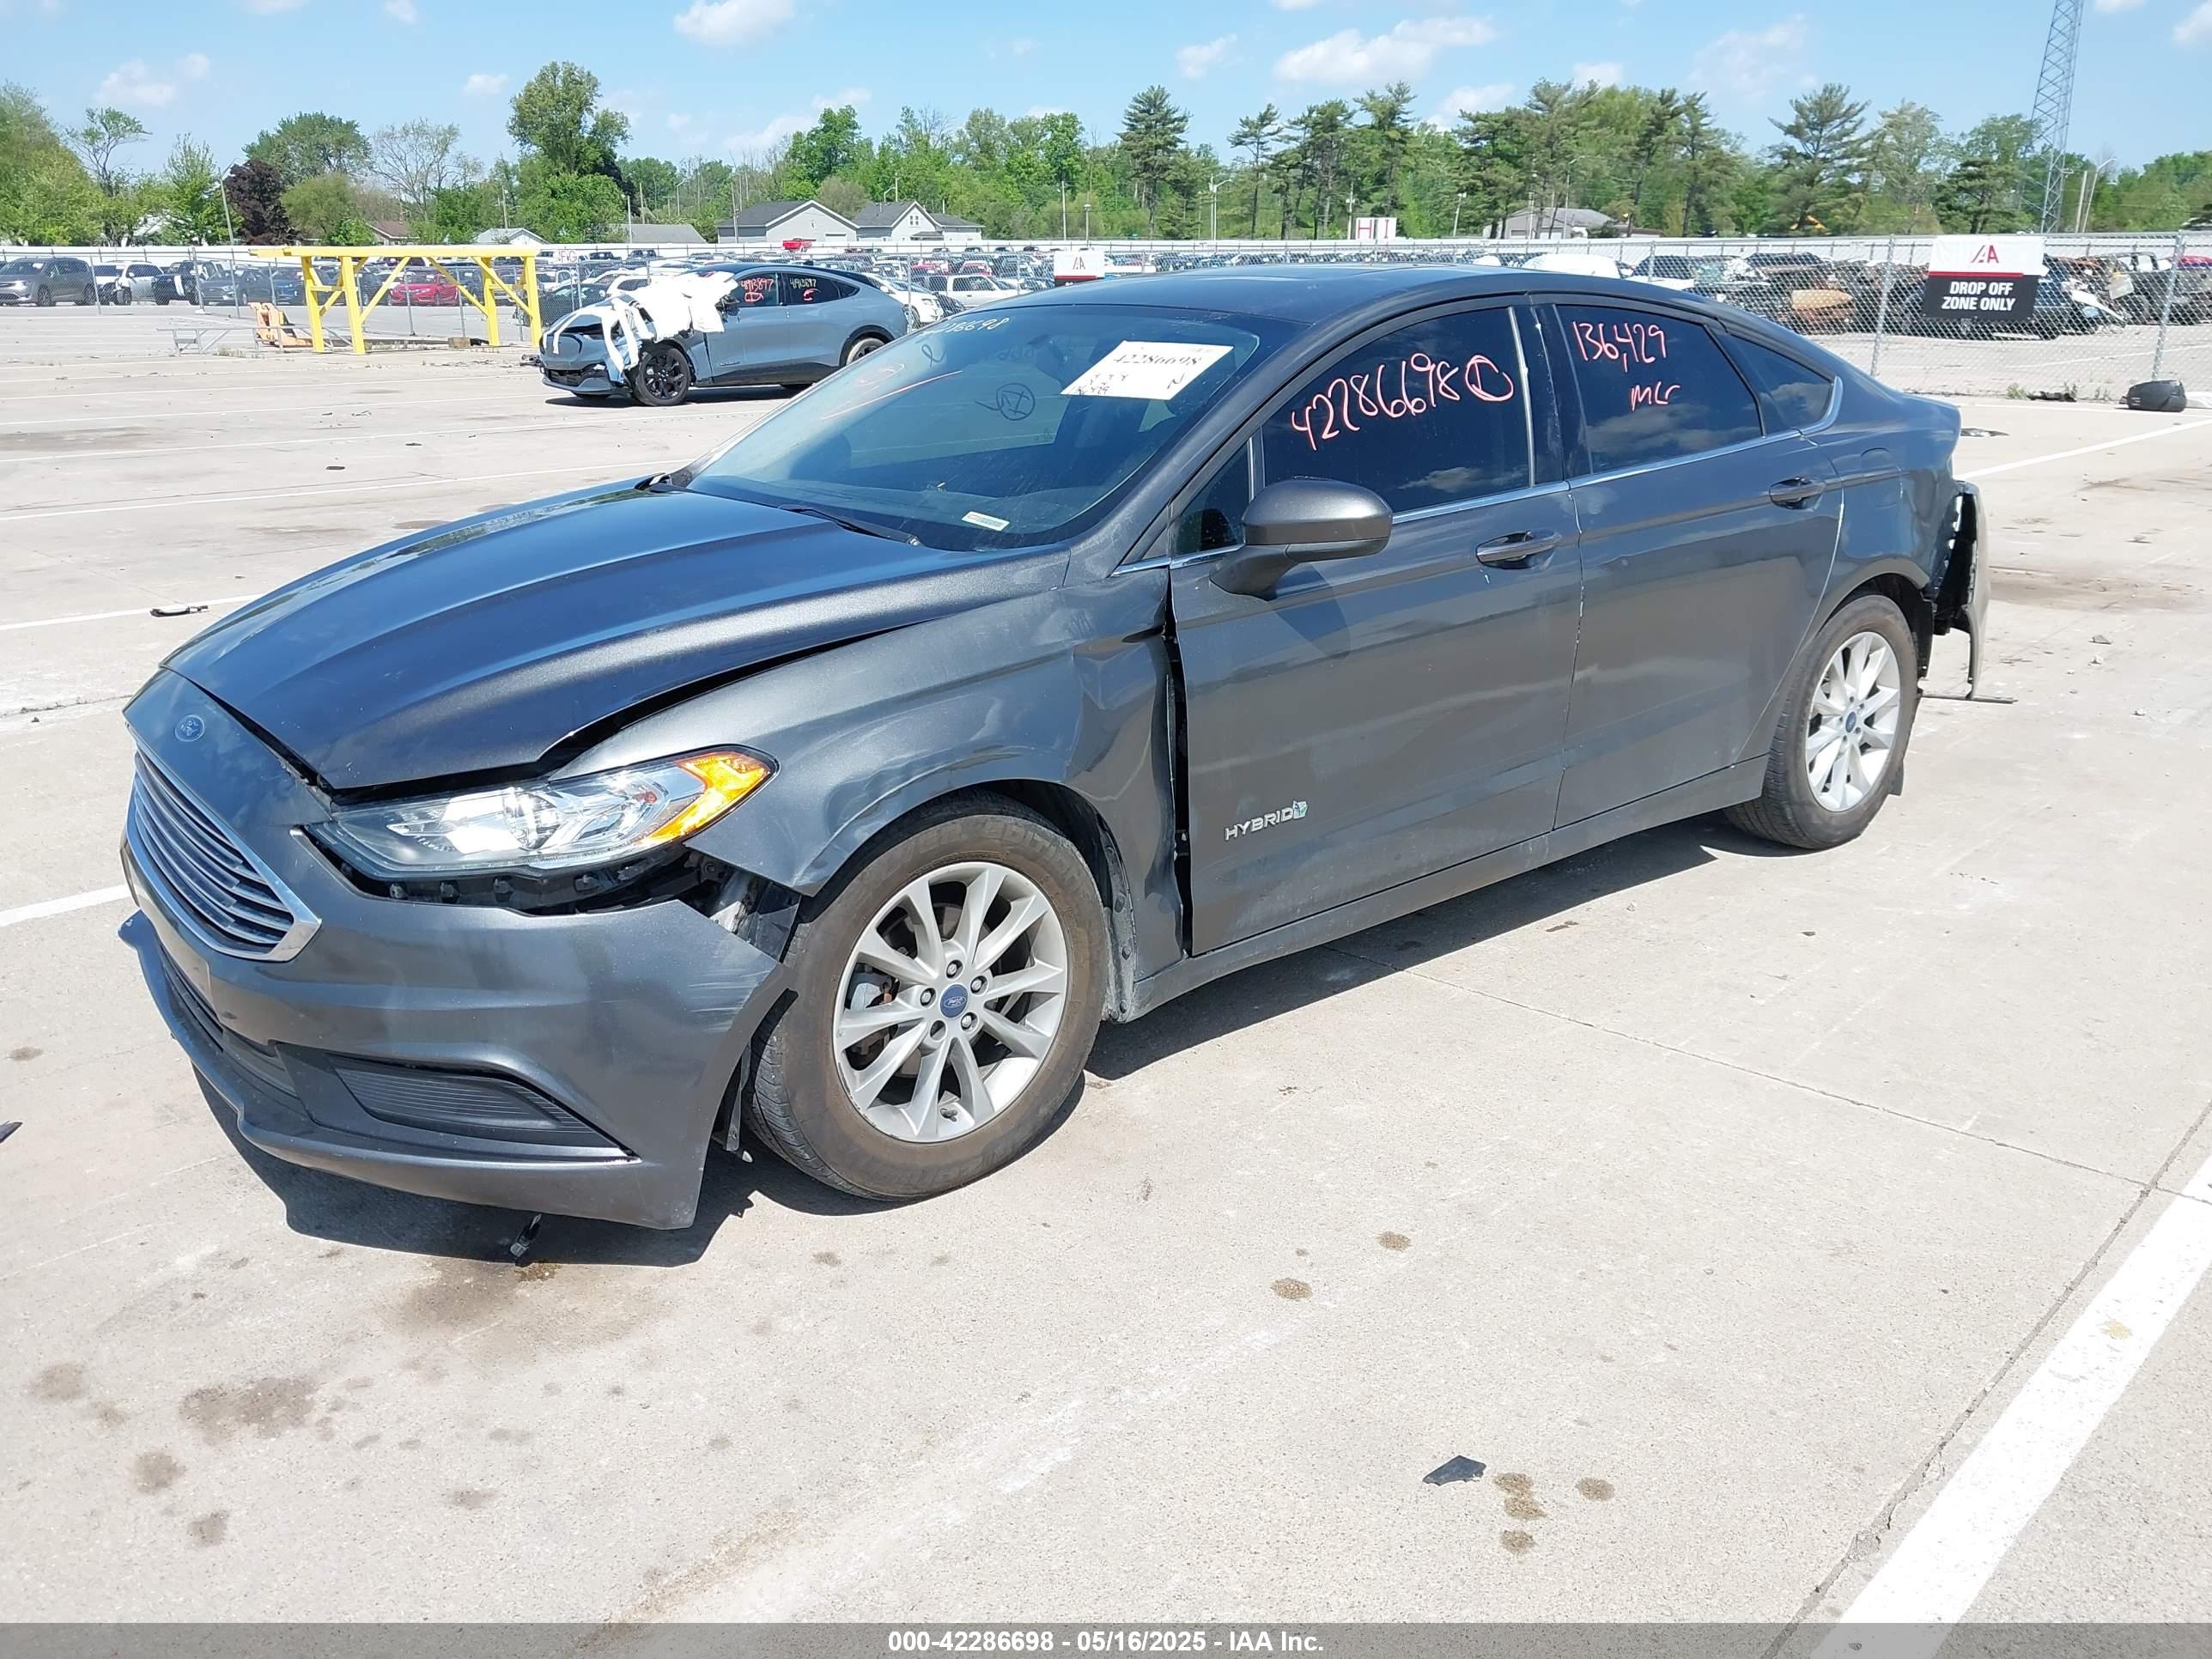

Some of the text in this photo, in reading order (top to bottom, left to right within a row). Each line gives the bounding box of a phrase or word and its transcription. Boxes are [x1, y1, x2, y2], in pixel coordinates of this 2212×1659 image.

[1950, 281, 2014, 295] DROP OFF
[1942, 296, 2016, 311] ZONE ONLY
[1224, 806, 1294, 841] HYBRID
